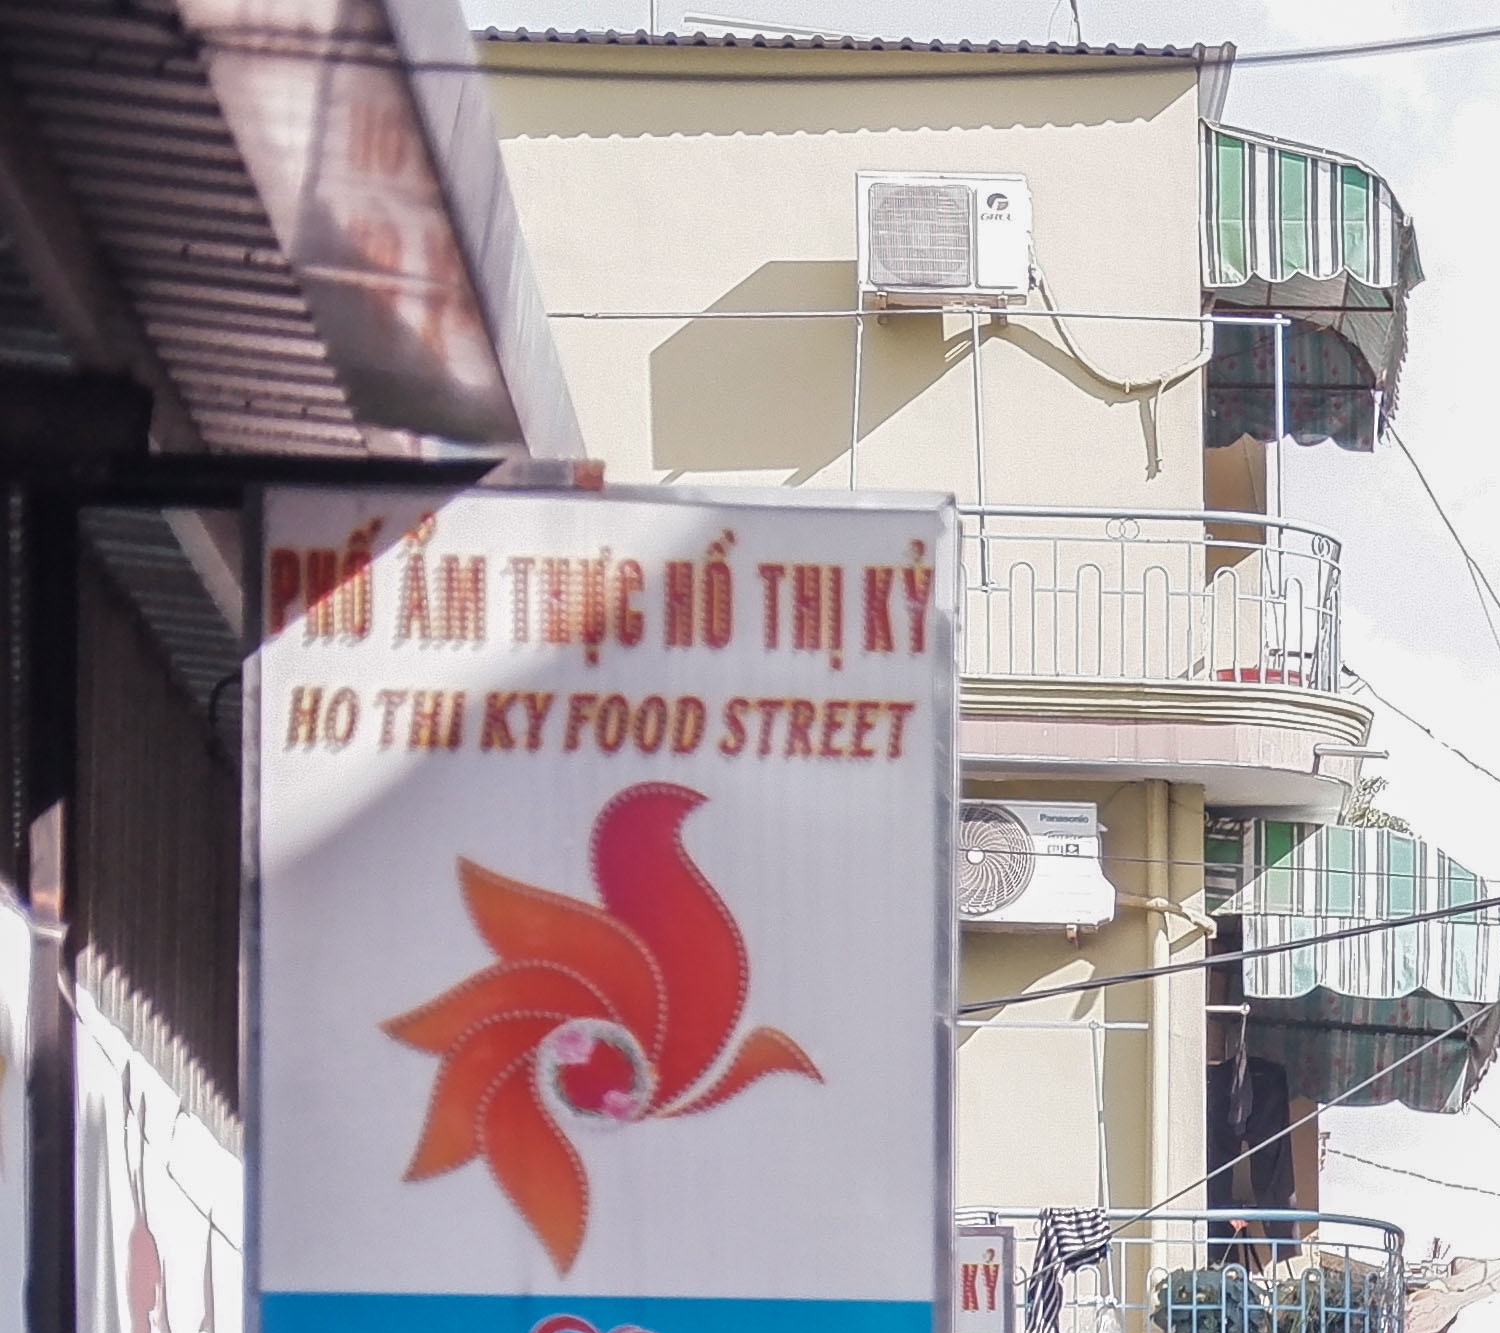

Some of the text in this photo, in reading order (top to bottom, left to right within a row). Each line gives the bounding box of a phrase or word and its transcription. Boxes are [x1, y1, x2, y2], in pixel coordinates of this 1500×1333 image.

[267, 517, 383, 641] PHỐ
[510, 548, 645, 668] THỰC
[756, 563, 845, 670] THỊ
[863, 538, 934, 654] KỶ
[284, 686, 915, 760] HO THI KY FOOD STREET
[1039, 813, 1089, 824] Panasonic
